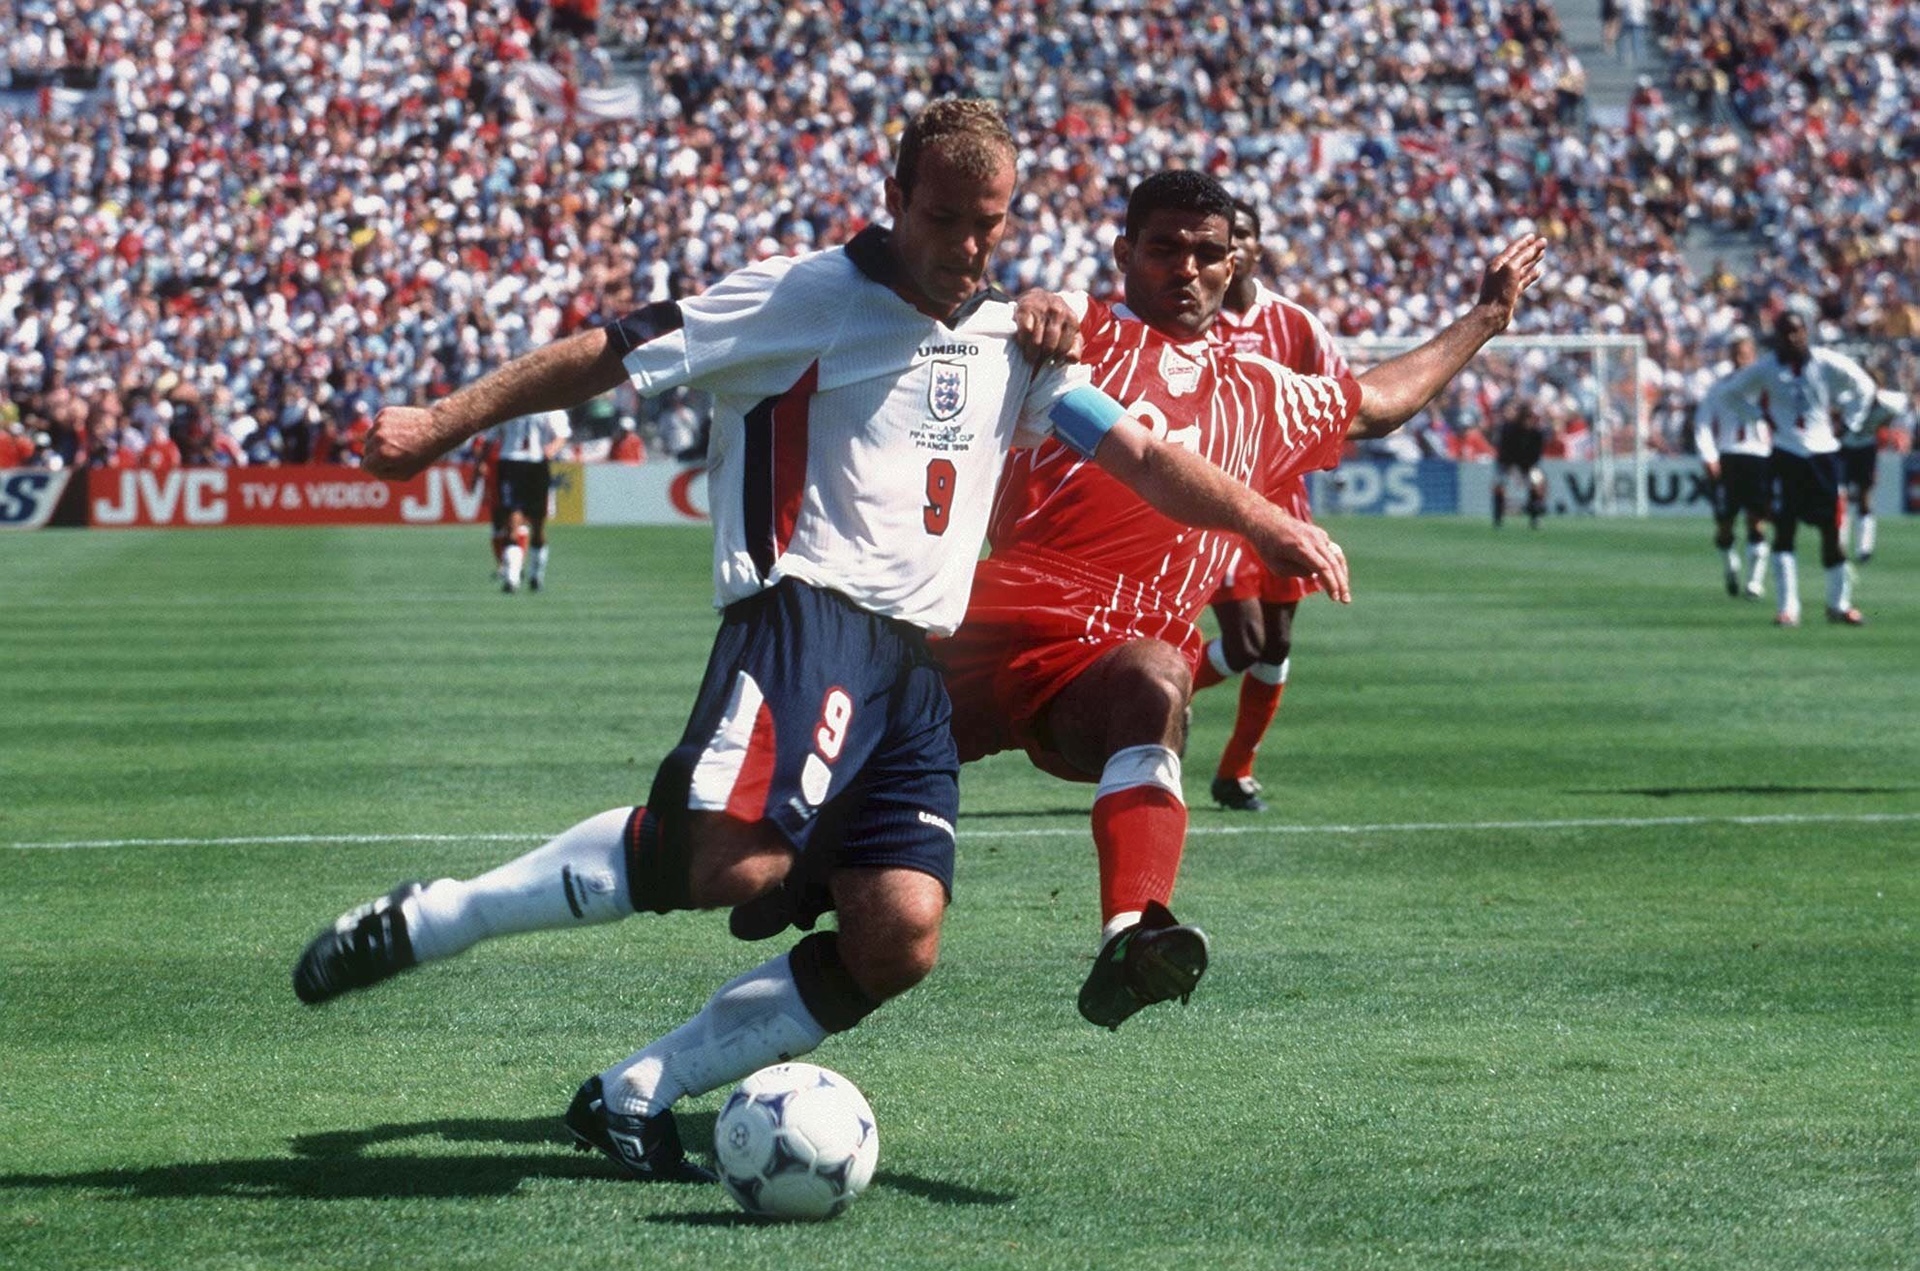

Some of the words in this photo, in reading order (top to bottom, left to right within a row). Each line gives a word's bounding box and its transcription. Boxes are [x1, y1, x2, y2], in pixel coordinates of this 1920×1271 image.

[918, 344, 979, 357] UMBRO
[916, 441, 949, 451] FRANCE
[94, 470, 229, 524] JVC
[241, 482, 277, 509] TV
[281, 482, 300, 509] &
[304, 481, 390, 509] VIDEO
[401, 467, 486, 522] JV
[923, 458, 957, 536] 9
[813, 686, 852, 763] 9
